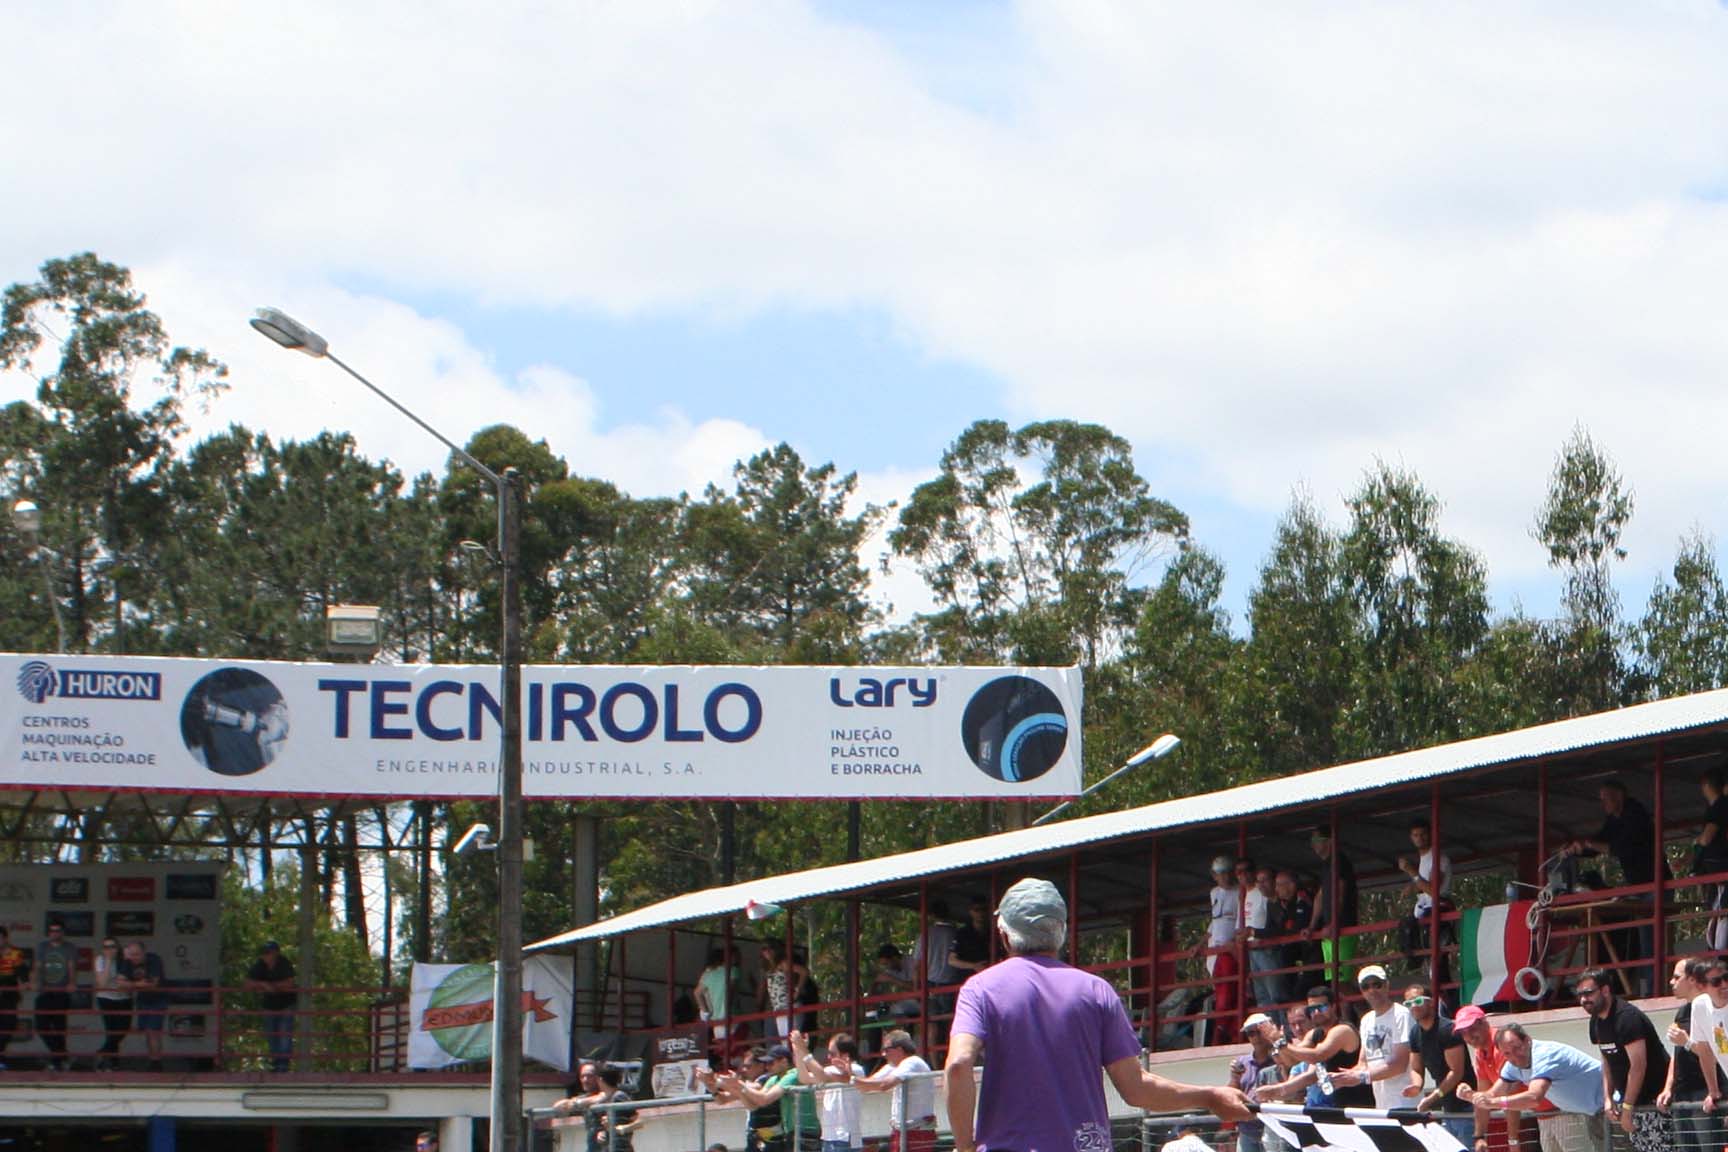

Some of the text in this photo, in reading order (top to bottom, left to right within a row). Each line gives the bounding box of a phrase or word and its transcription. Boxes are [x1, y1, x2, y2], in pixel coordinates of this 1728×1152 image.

[68, 672, 154, 697] HURON
[318, 679, 763, 743] TECNIROLO
[22, 715, 90, 728] CENTROS
[22, 731, 125, 749] MAQUINAÇÃO
[831, 726, 893, 743] INJEÇÃO
[22, 750, 157, 765] ALTA VELOCIDADE
[831, 744, 900, 758] PLÁSTICO
[663, 761, 703, 776] S.A.
[831, 763, 923, 775] E BORRACHA
